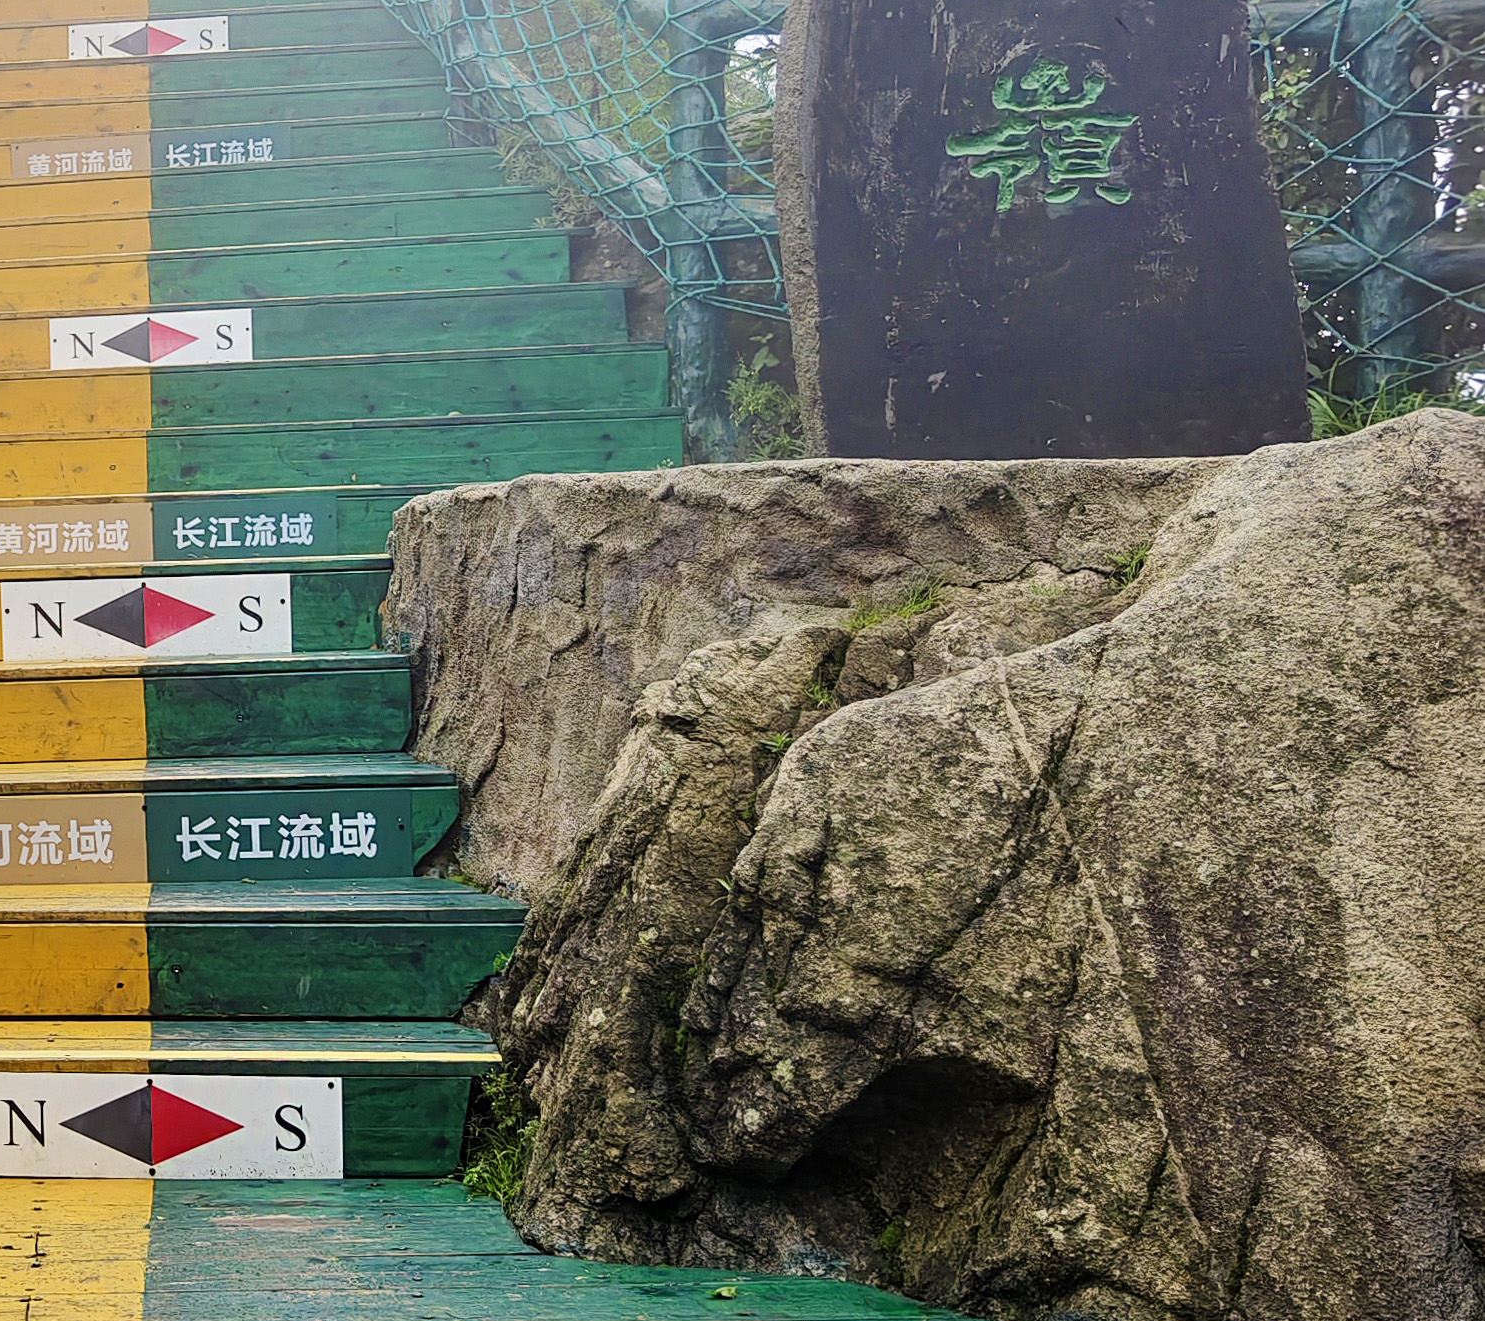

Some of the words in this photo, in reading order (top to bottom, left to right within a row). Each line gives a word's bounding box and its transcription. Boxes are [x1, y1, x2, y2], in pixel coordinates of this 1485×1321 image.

[84, 35, 104, 57] N
[199, 29, 214, 51] S
[27, 148, 133, 177] 黄河流域
[166, 138, 274, 167] 长江流域
[69, 332, 96, 359] N
[216, 324, 234, 351] S
[172, 512, 315, 550] 长江流域
[28, 601, 66, 639] N
[238, 595, 264, 633] S
[175, 811, 378, 862] 长江流域
[0, 1099, 47, 1148] N
[274, 1104, 308, 1152] S
